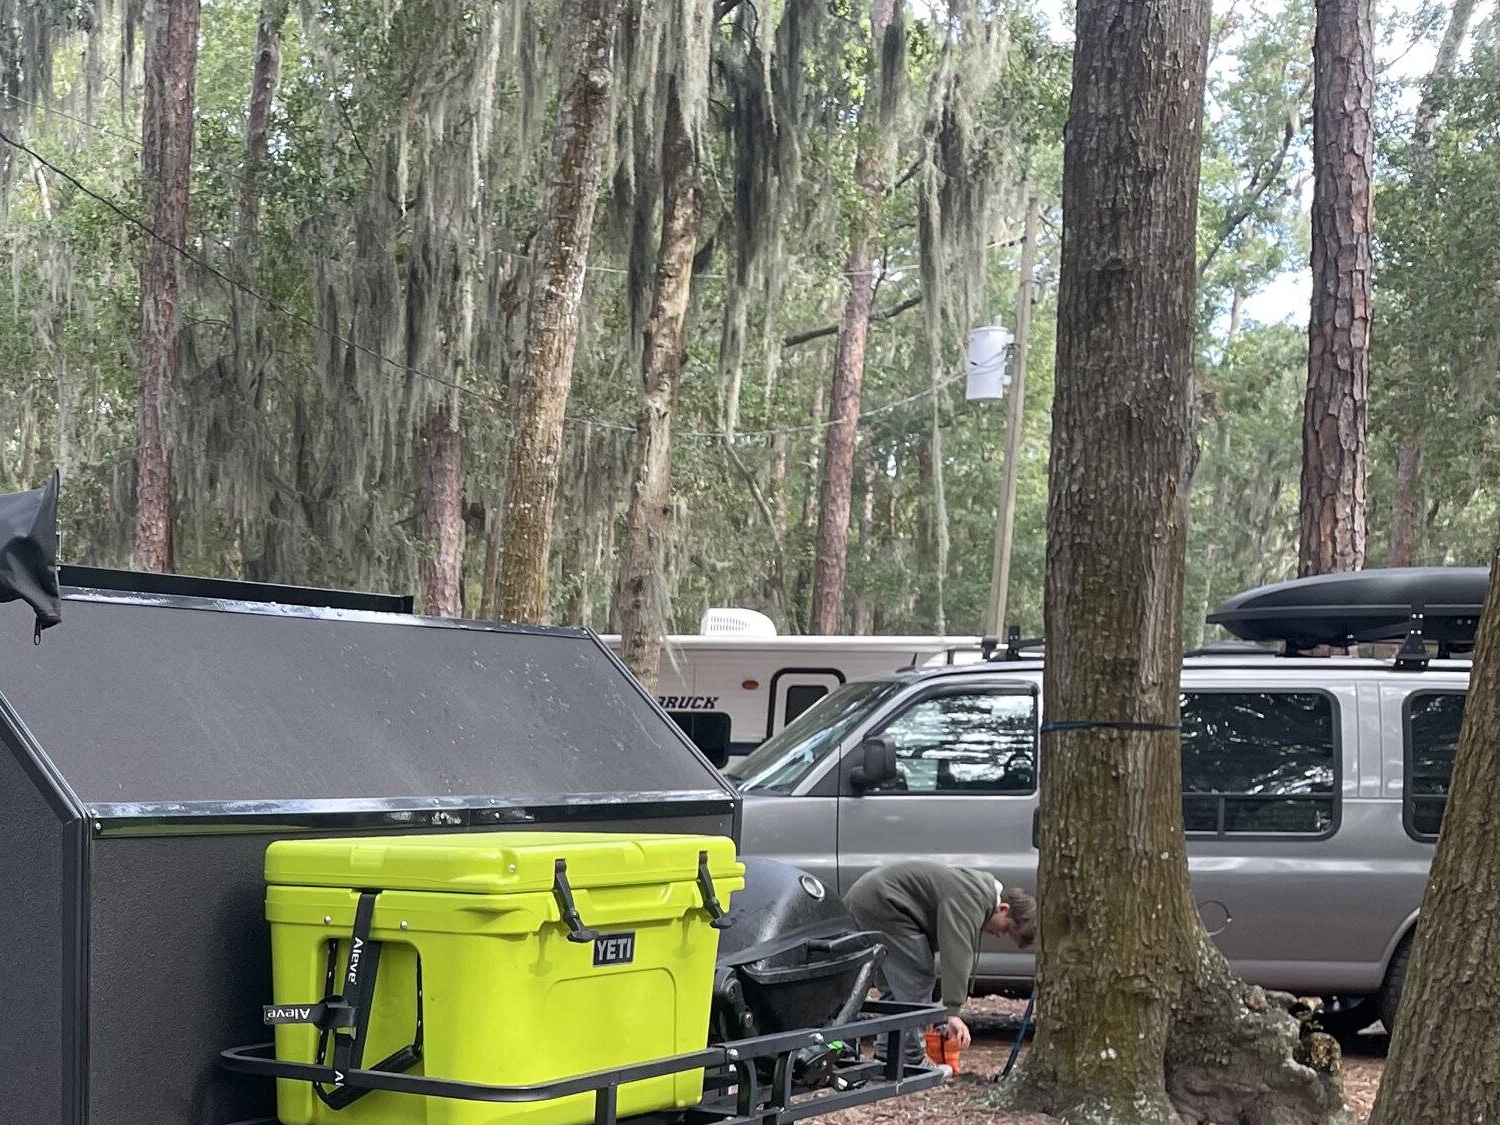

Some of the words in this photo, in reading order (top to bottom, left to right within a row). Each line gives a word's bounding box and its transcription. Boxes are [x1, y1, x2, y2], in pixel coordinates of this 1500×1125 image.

[348, 936, 364, 984] Aleve
[596, 938, 632, 961] YETI
[267, 1007, 311, 1020] Aleve
